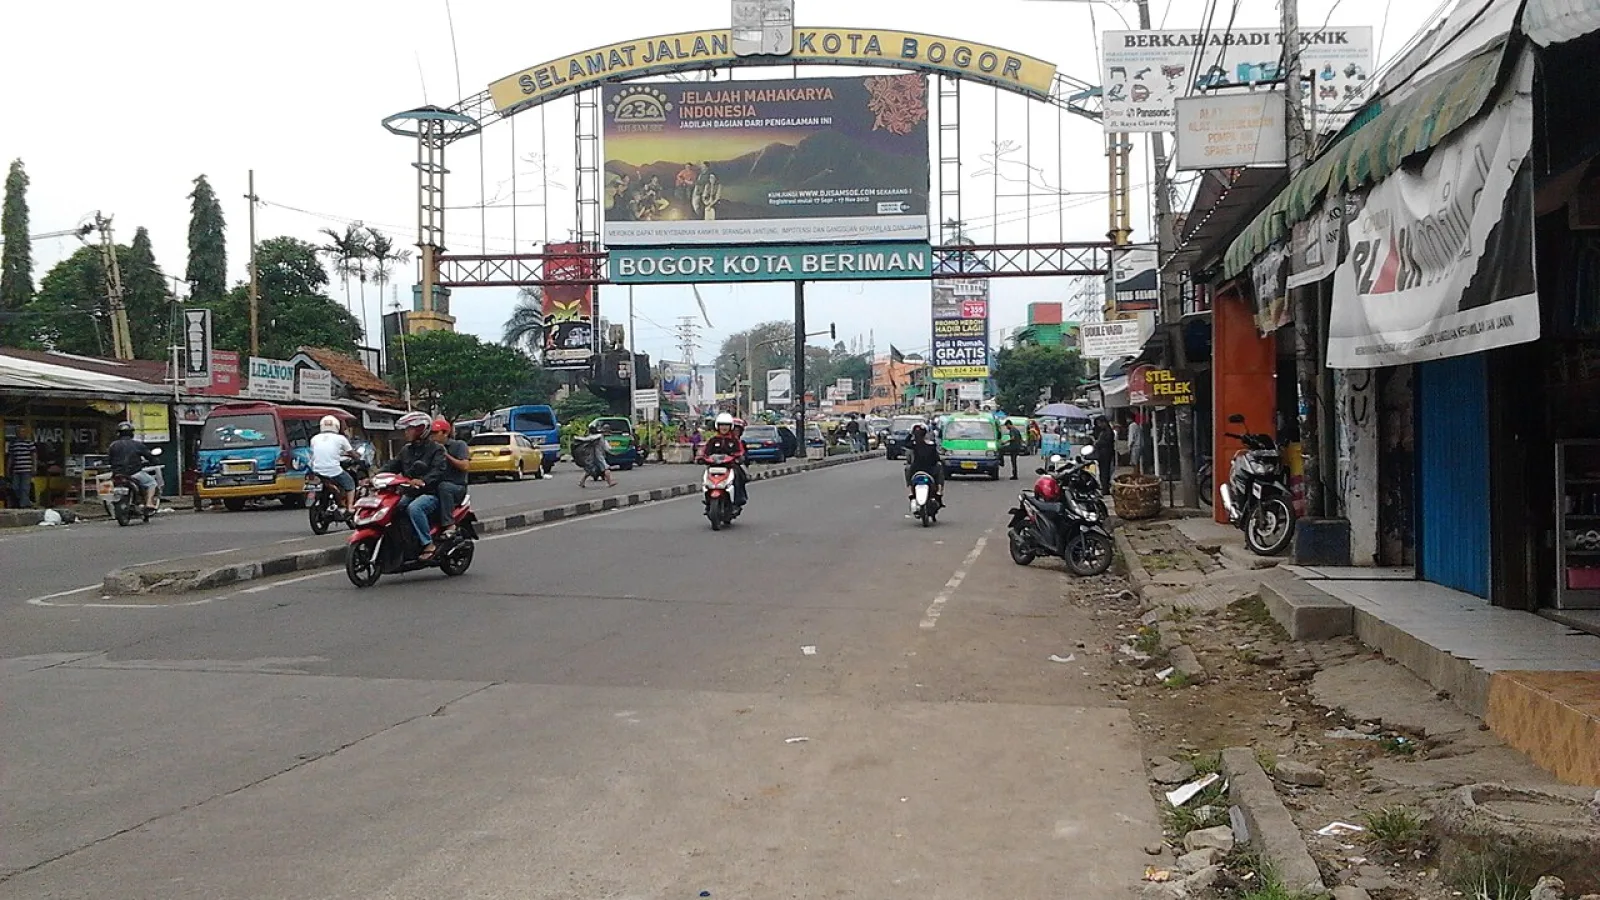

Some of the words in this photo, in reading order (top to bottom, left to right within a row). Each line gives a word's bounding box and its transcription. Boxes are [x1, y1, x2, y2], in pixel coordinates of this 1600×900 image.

[1124, 34, 1204, 47] BERKAH
[1209, 33, 1270, 46] ABADI
[1275, 31, 1348, 45] TKNIK
[518, 45, 636, 95] SELAMAT
[642, 34, 729, 63] JALAN
[799, 32, 882, 56] KOTA
[901, 38, 1022, 79] BOGOR
[679, 91, 741, 104] JELAJAH
[743, 88, 833, 102] MAHAKARYA
[621, 101, 660, 118] 234
[679, 105, 757, 119] INDONESIA
[1136, 108, 1170, 117] Panasonic
[679, 120, 712, 129] JADILAH
[713, 119, 743, 128] BAGIAN
[744, 118, 764, 127] DARI
[765, 117, 819, 127] PENGALAMAN
[821, 117, 832, 125] INI
[619, 255, 716, 276] BOGOR
[723, 254, 794, 274] KOTA
[802, 252, 925, 272] BERIMAN
[936, 347, 986, 359] GRATIS
[251, 362, 294, 381] LIBANON
[1145, 369, 1175, 383] STEL
[1153, 381, 1191, 396] PELEK
